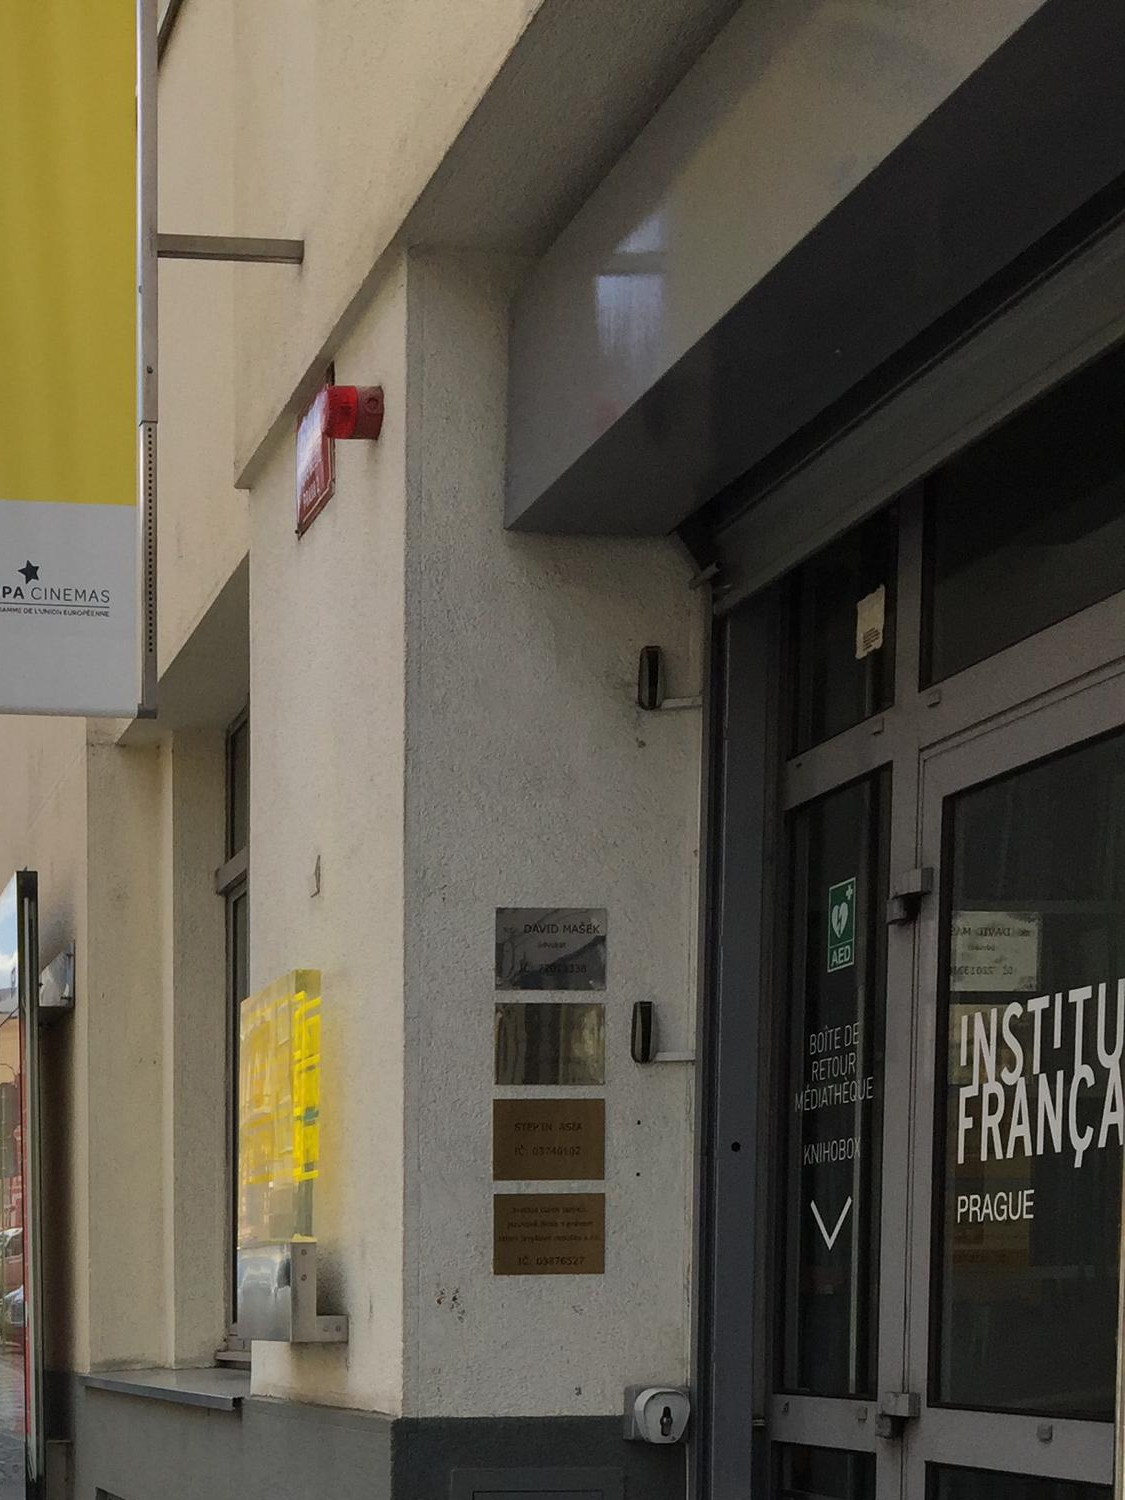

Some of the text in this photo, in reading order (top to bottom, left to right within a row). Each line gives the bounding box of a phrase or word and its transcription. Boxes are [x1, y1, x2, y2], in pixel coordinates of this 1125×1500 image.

[30, 586, 110, 603] CINEMAS
[523, 923, 559, 934] DAVID
[562, 921, 601, 934] MAŠEK
[831, 945, 852, 967] AED
[809, 1021, 860, 1056] BOÎTE DE
[960, 978, 1125, 1090] INSTITU
[811, 1052, 857, 1082] RETOUR
[794, 1076, 875, 1113] MÉDIATHÈQUE
[957, 1064, 1125, 1169] FRANÇA
[803, 1136, 862, 1166] KNIHOBOX
[957, 1189, 1035, 1224] PRAGUE
